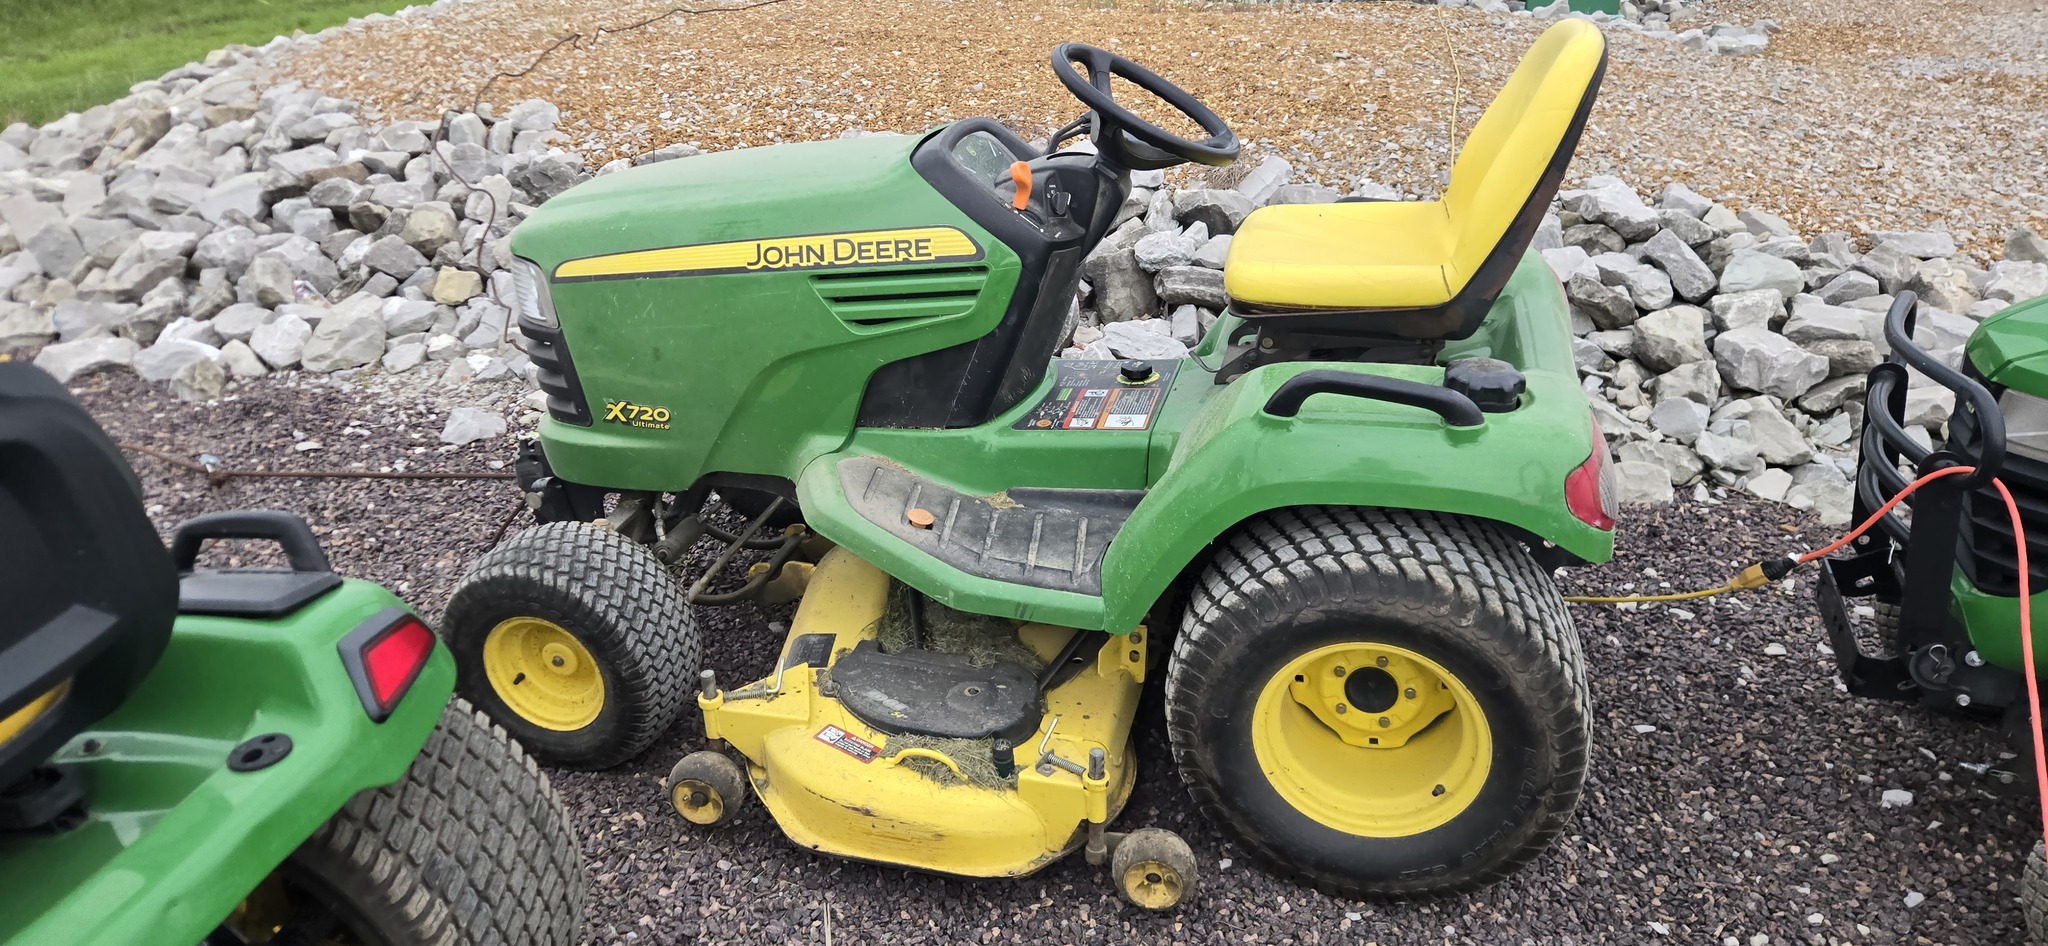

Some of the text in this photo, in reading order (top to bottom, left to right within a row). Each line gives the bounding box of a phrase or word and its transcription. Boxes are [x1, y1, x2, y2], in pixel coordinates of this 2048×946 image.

[747, 238, 932, 267] JOHN DEERE
[605, 401, 670, 422] X720
[632, 420, 670, 430] Ultimate
